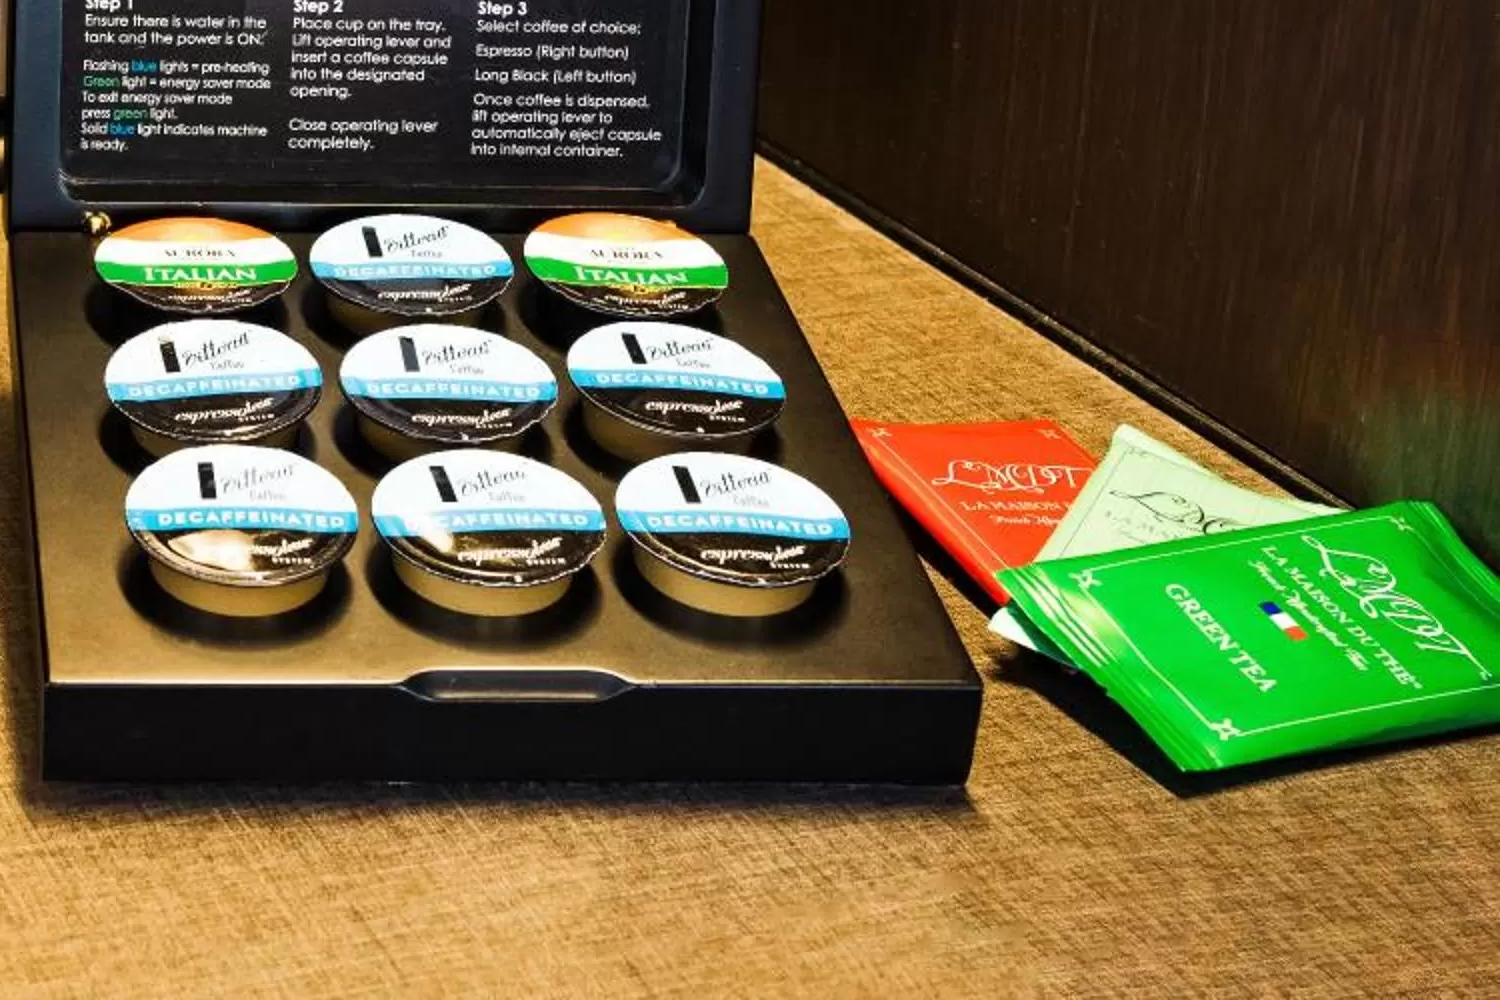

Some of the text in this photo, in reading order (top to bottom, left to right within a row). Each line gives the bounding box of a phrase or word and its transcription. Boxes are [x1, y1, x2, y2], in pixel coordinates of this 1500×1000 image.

[477, 1, 528, 18] Step 3
[85, 14, 267, 30] Ensure there is water in the
[292, 17, 447, 34] Place cup on the tray.
[475, 19, 519, 33] Select
[523, 20, 569, 34] coffee
[571, 20, 587, 34] of
[84, 30, 115, 44] tank
[118, 31, 147, 44] and
[151, 31, 172, 45] the
[176, 33, 221, 47] power
[225, 32, 234, 45] is
[291, 34, 452, 50] Lift operating lever and
[330, 53, 341, 64] a
[343, 52, 390, 65] coffee
[393, 52, 449, 66] capsule
[475, 43, 630, 61] Espresso (Right button)
[83, 59, 129, 74] Flashing
[131, 59, 157, 73] blue
[160, 60, 189, 75] lights
[201, 61, 270, 76] pre-heating
[290, 67, 425, 83] into the designated
[83, 75, 120, 88] Green
[122, 76, 147, 91] light
[159, 78, 200, 91] energy
[202, 78, 234, 90] saver
[235, 78, 271, 90] mode
[474, 68, 637, 86] Long Black (Left button)
[82, 90, 233, 106] To exit energy saver mode
[289, 84, 352, 100] opening.
[473, 93, 513, 107] Once
[516, 94, 561, 108] coffee
[564, 94, 574, 108] is
[81, 107, 178, 122] press green light.
[471, 109, 613, 126] lift operating lever to
[80, 122, 268, 137] Solid blue light indicates machine
[288, 117, 439, 135] Close operating lever
[471, 126, 663, 143] automatically eject capsule
[80, 137, 129, 152] is ready.
[287, 135, 375, 151] completely.
[470, 142, 624, 158] into internal container.
[144, 266, 257, 281] ITALIAN
[573, 266, 688, 285] ITALIAN
[128, 375, 301, 397] DECAFFEINATED
[367, 383, 541, 398] DECAFFEINATED
[596, 373, 769, 394] DECAFFEINATED
[158, 510, 346, 526] DECAFFEINATED
[435, 512, 589, 527] CAFFEINATED
[648, 514, 834, 536] DECAFFEINATED
[1261, 546, 1288, 567] LA
[1284, 567, 1354, 623] MAISON
[1348, 625, 1381, 647] DU
[1165, 583, 1240, 651] GREEN
[1228, 649, 1277, 692] TEA
